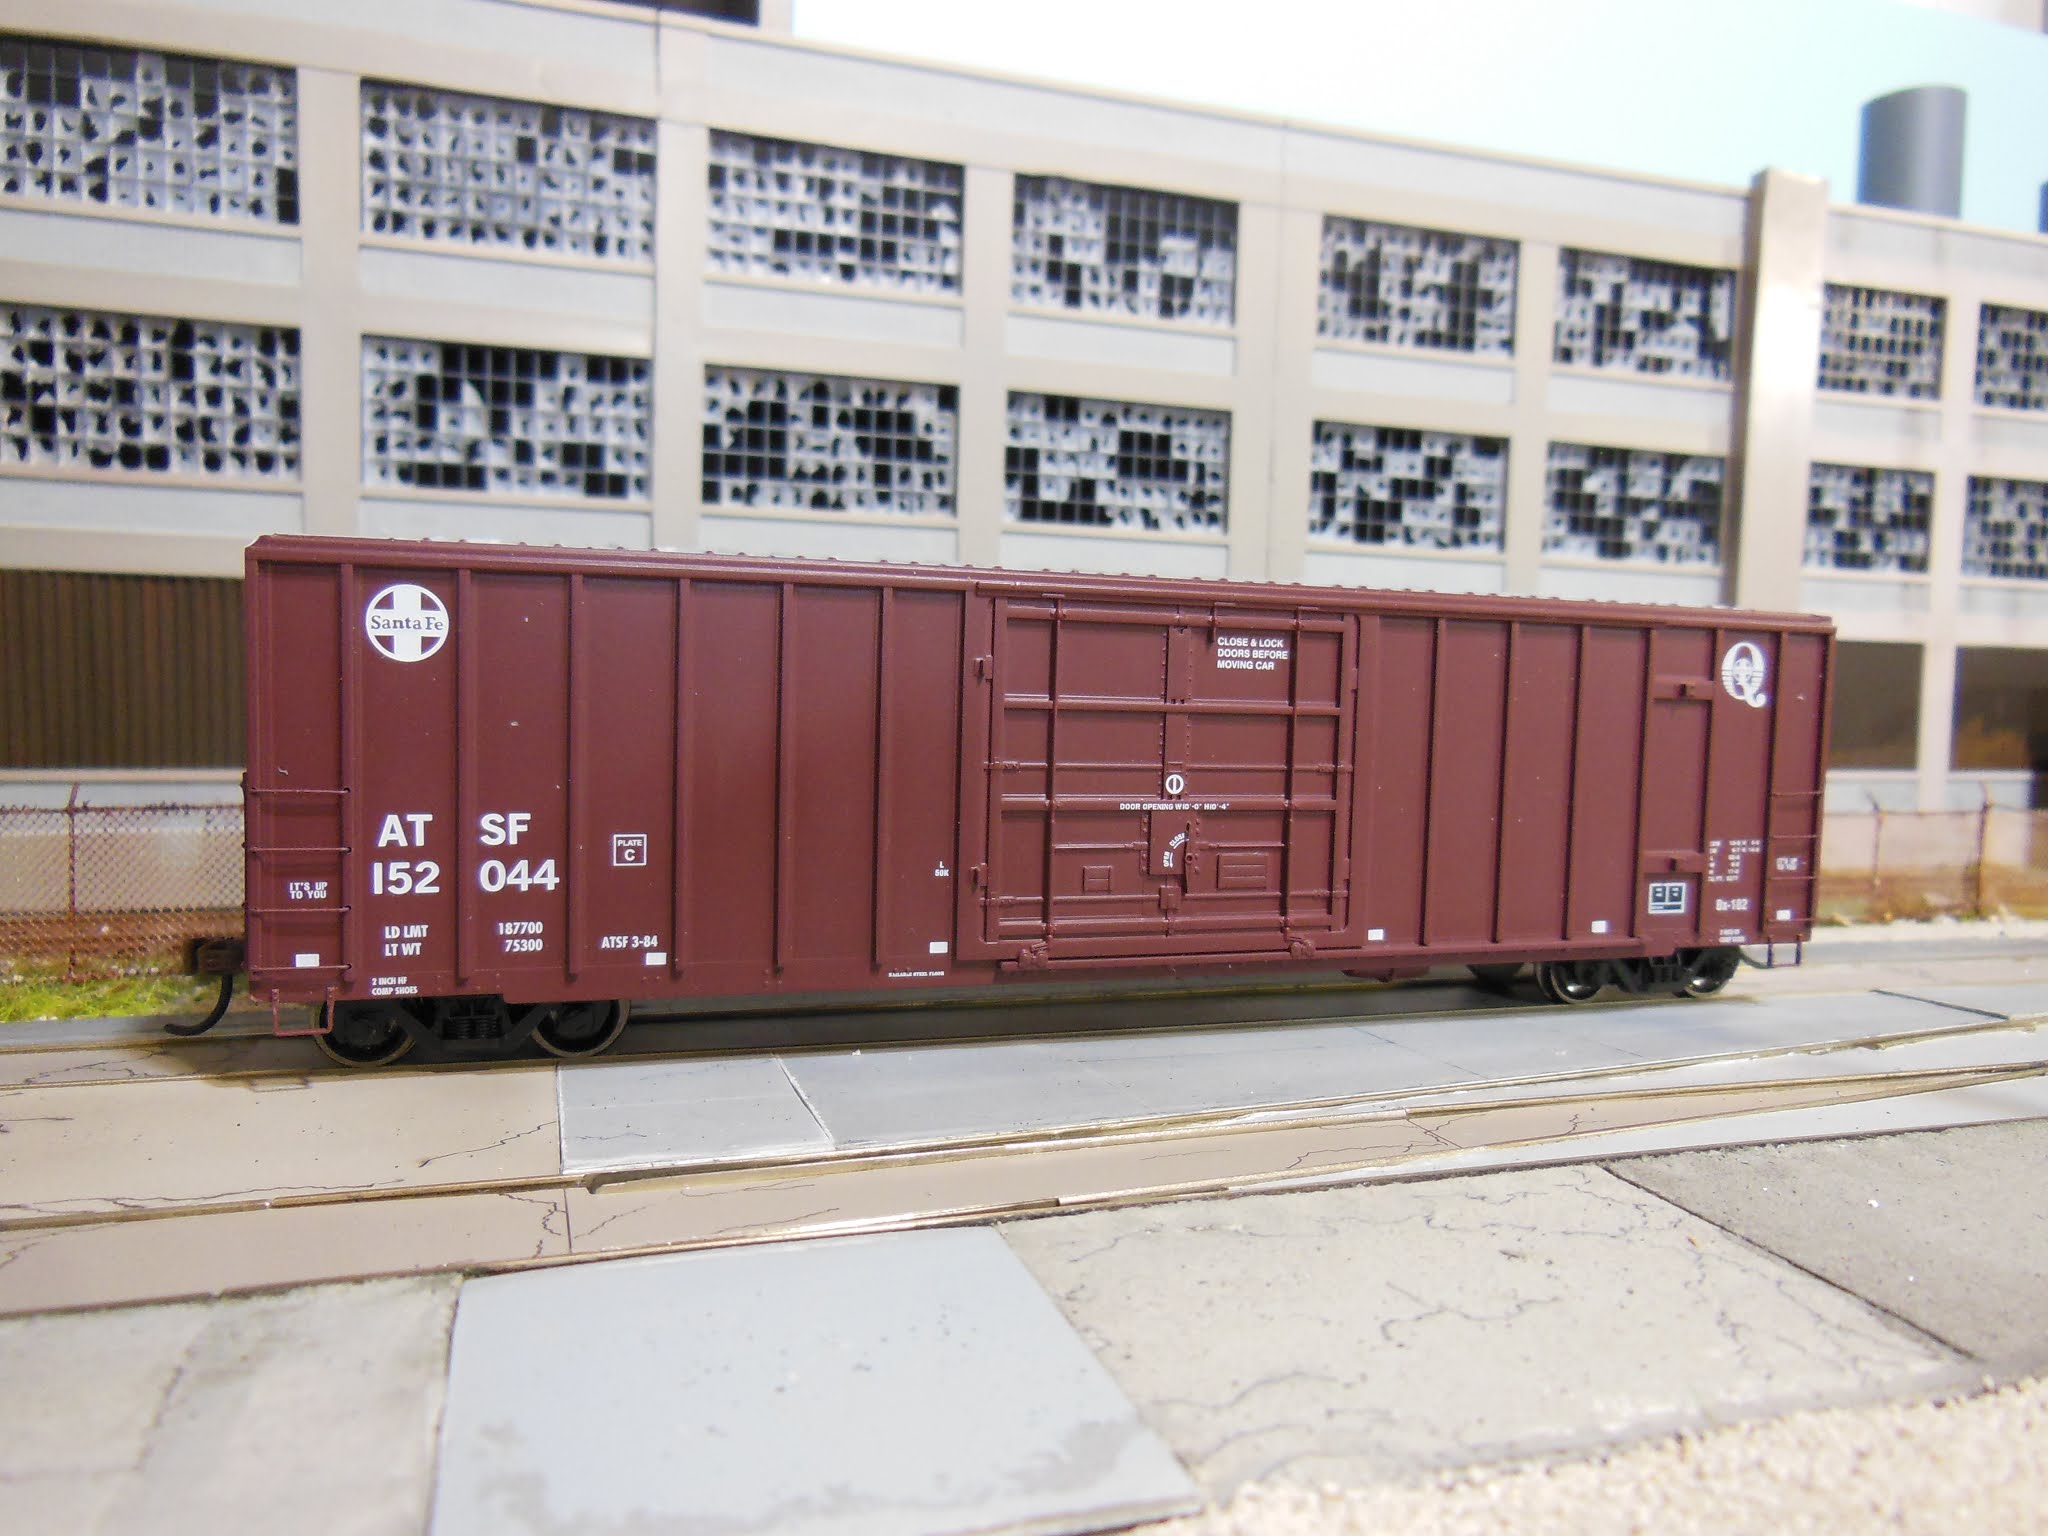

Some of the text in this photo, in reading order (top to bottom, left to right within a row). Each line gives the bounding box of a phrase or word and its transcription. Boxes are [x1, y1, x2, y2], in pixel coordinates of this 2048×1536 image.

[371, 614, 444, 631] Santa Fe
[1217, 637, 1284, 648] CLOSE & LOCK
[1217, 648, 1288, 660] DOORS BEFORE
[1217, 660, 1275, 671] MOVING CAR
[378, 813, 532, 847] AT SF
[624, 849, 636, 861] C
[939, 860, 945, 869] L
[373, 859, 560, 895] 152 044
[289, 882, 328, 891] IT'S UP
[290, 890, 327, 900] TO YOU
[385, 921, 543, 938] LD LMT 187700
[385, 938, 543, 957] LT WT 75300
[601, 935, 658, 949] ATSF 3-84
[371, 976, 408, 986] 2 INCH HF
[371, 985, 419, 996] COMP SHOES
